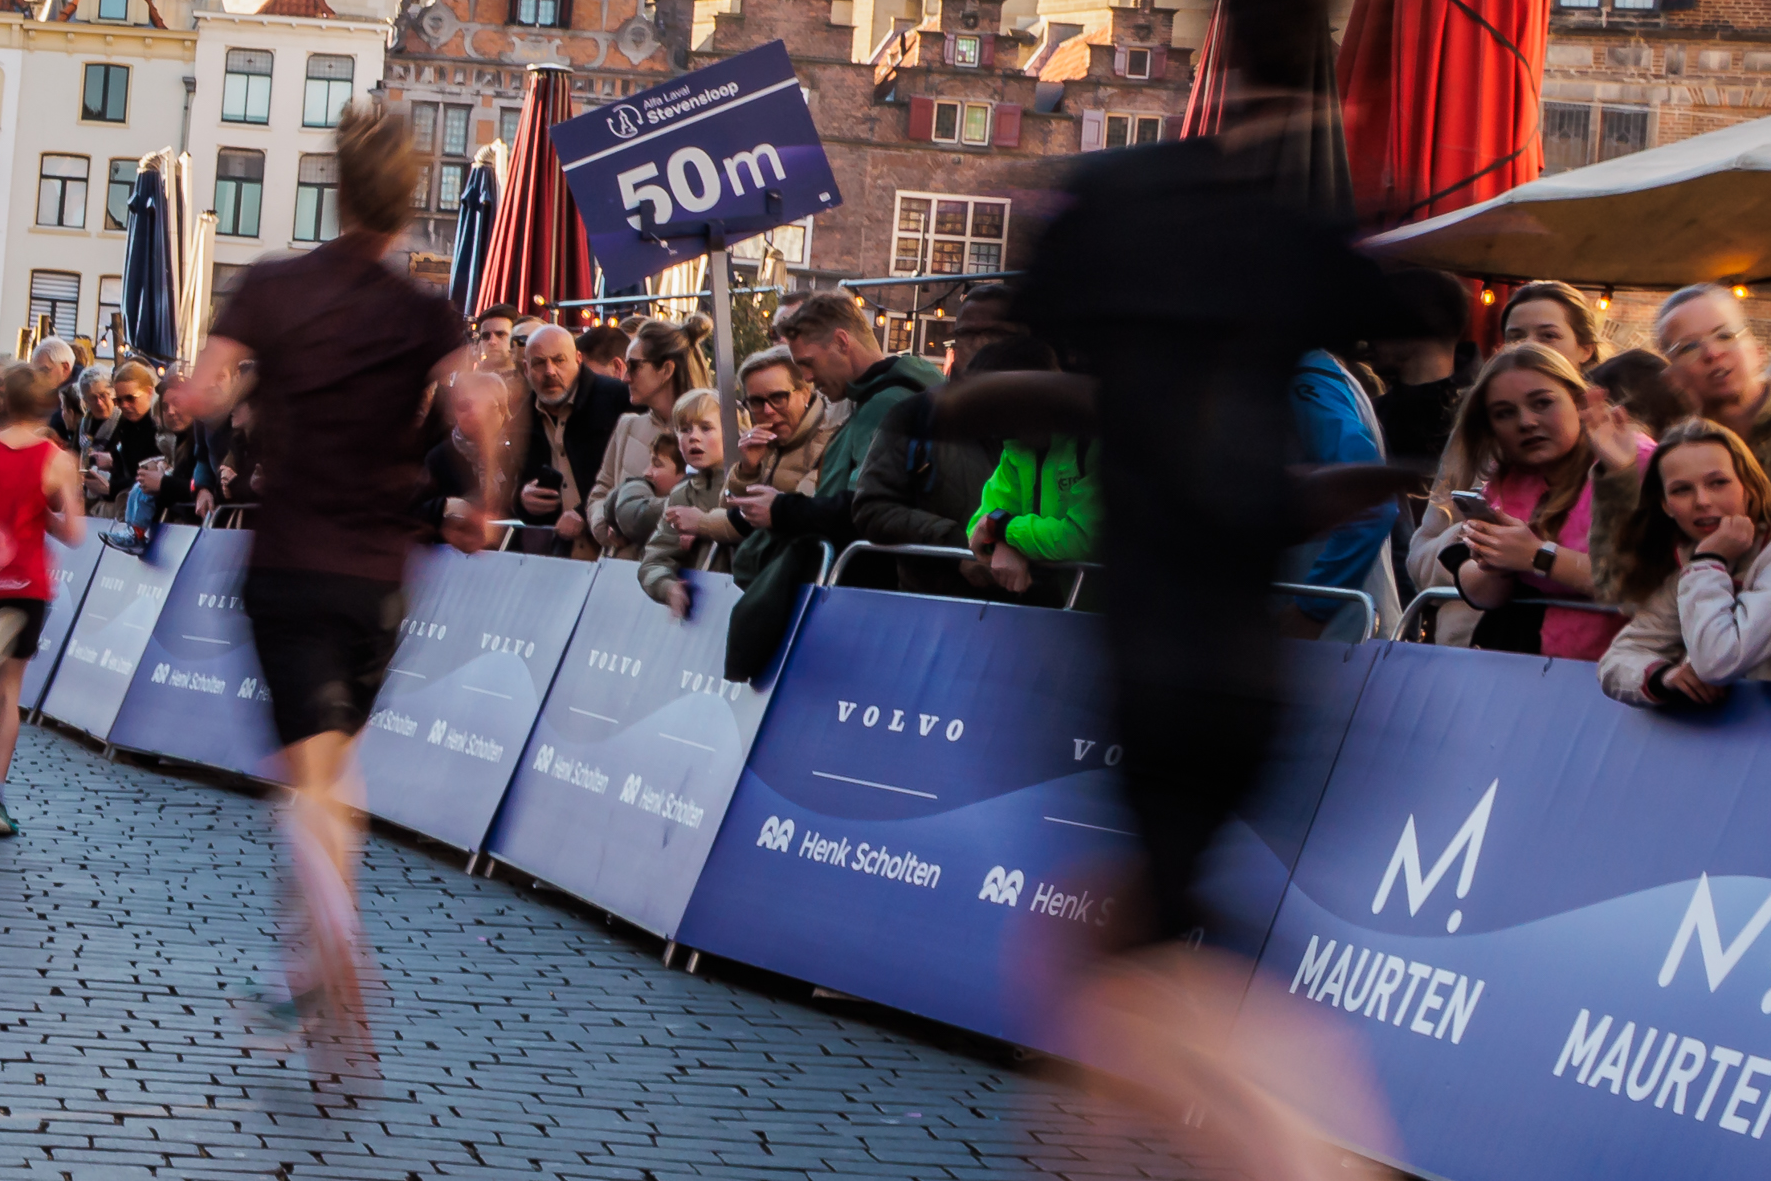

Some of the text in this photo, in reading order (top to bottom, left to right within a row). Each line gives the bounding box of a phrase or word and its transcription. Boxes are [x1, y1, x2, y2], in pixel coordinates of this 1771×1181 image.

[643, 84, 691, 111] Alfa Laval
[646, 81, 739, 125] Stevensloop
[480, 631, 536, 659] VOLVO
[588, 648, 643, 678] VOLVO
[837, 700, 965, 743] VOLVO
[798, 829, 943, 890] Henk Scholten
[1029, 881, 1095, 924] Henk
[1289, 934, 1486, 1045] MAURTEN
[1552, 1007, 1771, 1140] MAURTE
